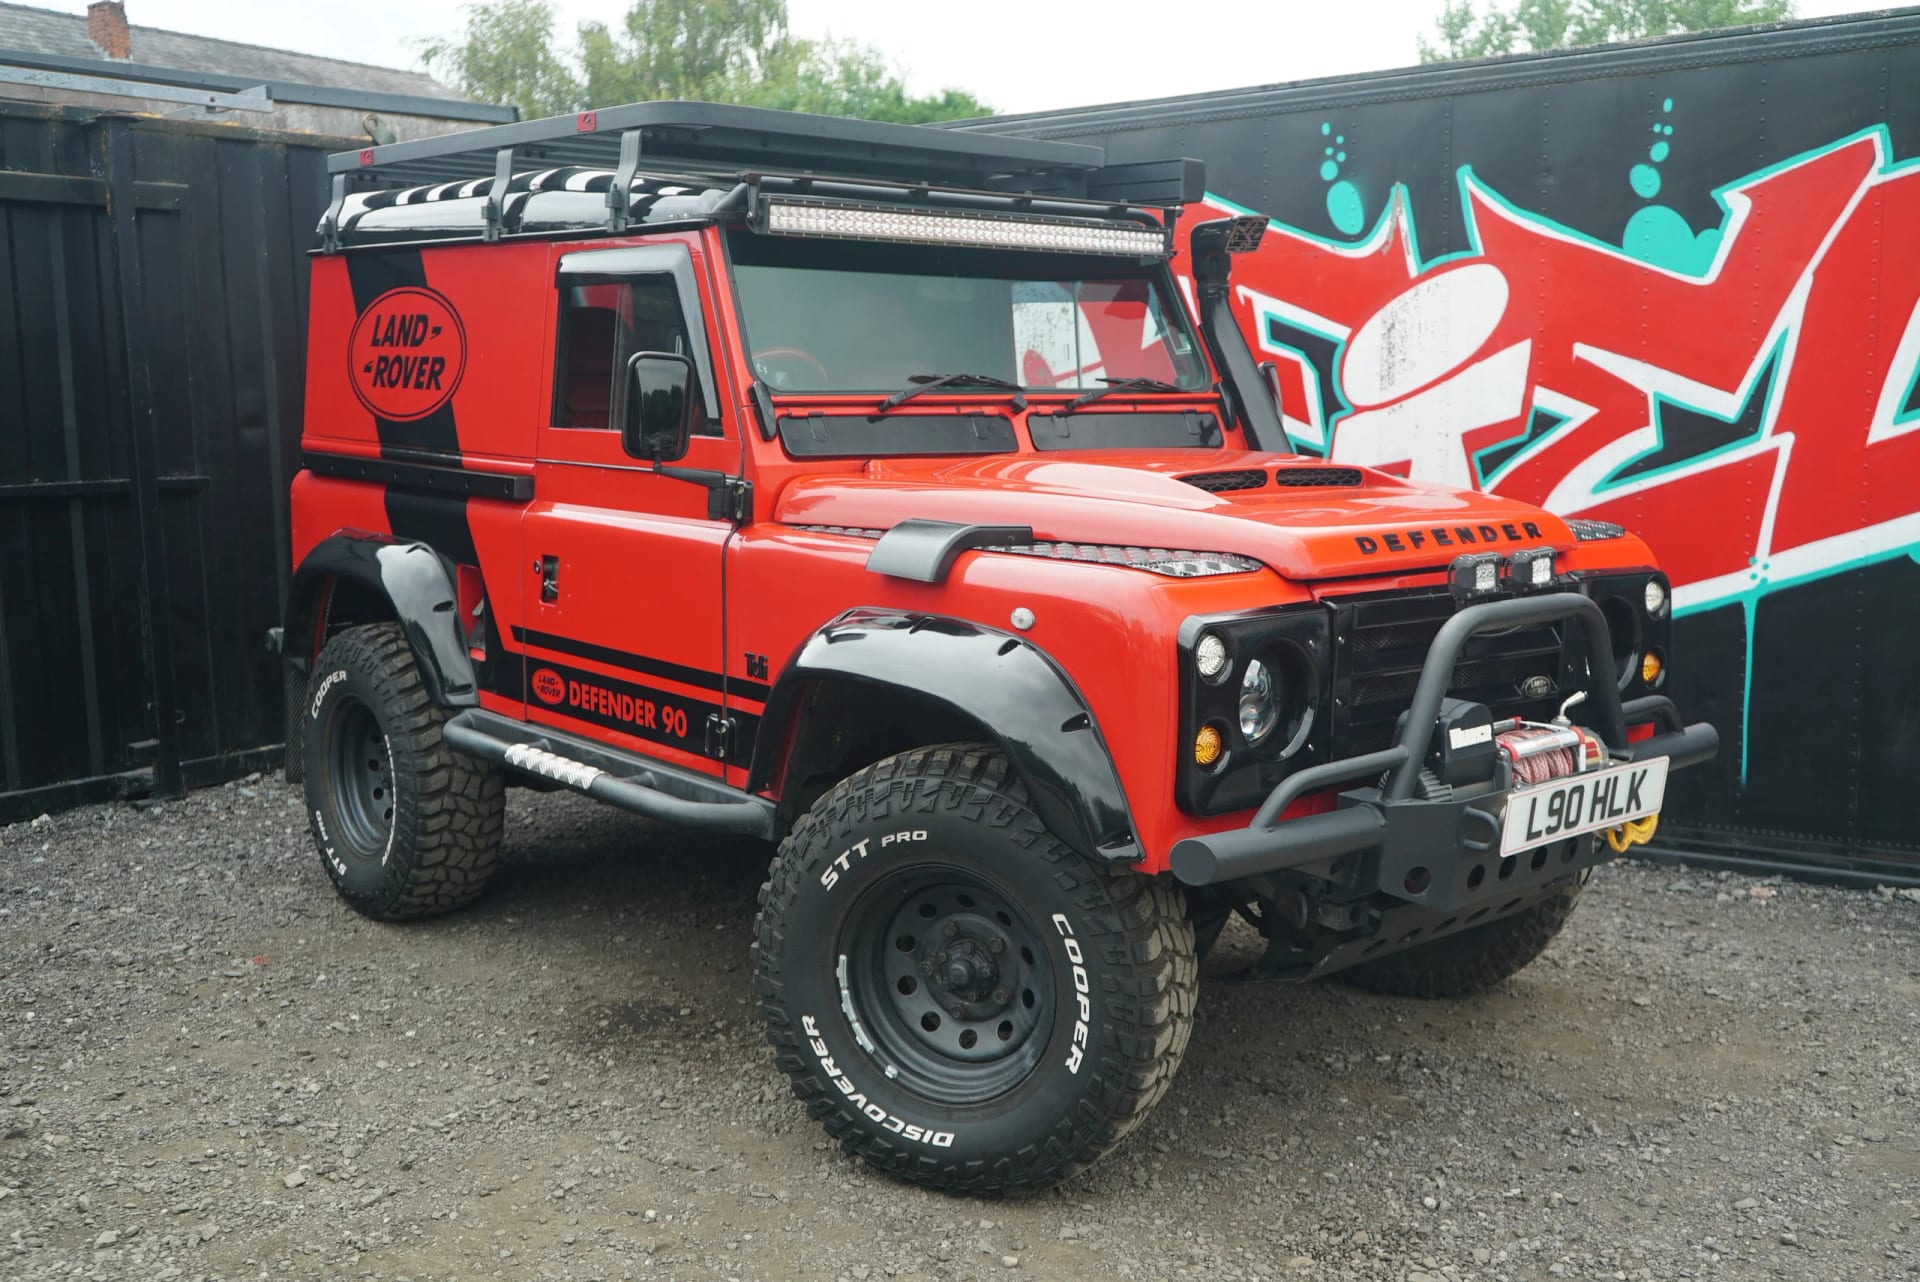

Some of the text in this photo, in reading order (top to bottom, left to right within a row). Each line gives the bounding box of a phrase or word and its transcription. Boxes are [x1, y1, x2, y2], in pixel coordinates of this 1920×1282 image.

[371, 314, 429, 347] LAND
[372, 355, 446, 390] ROVER
[1355, 522, 1542, 555] DEFENDER
[311, 670, 347, 720] COOPER
[569, 681, 687, 739] DEFENDER 90
[1526, 769, 1648, 842] L90 HLK
[820, 829, 928, 892] STT PRO
[1052, 912, 1090, 1075] COOPER
[801, 1014, 955, 1148] DISCOVERER
